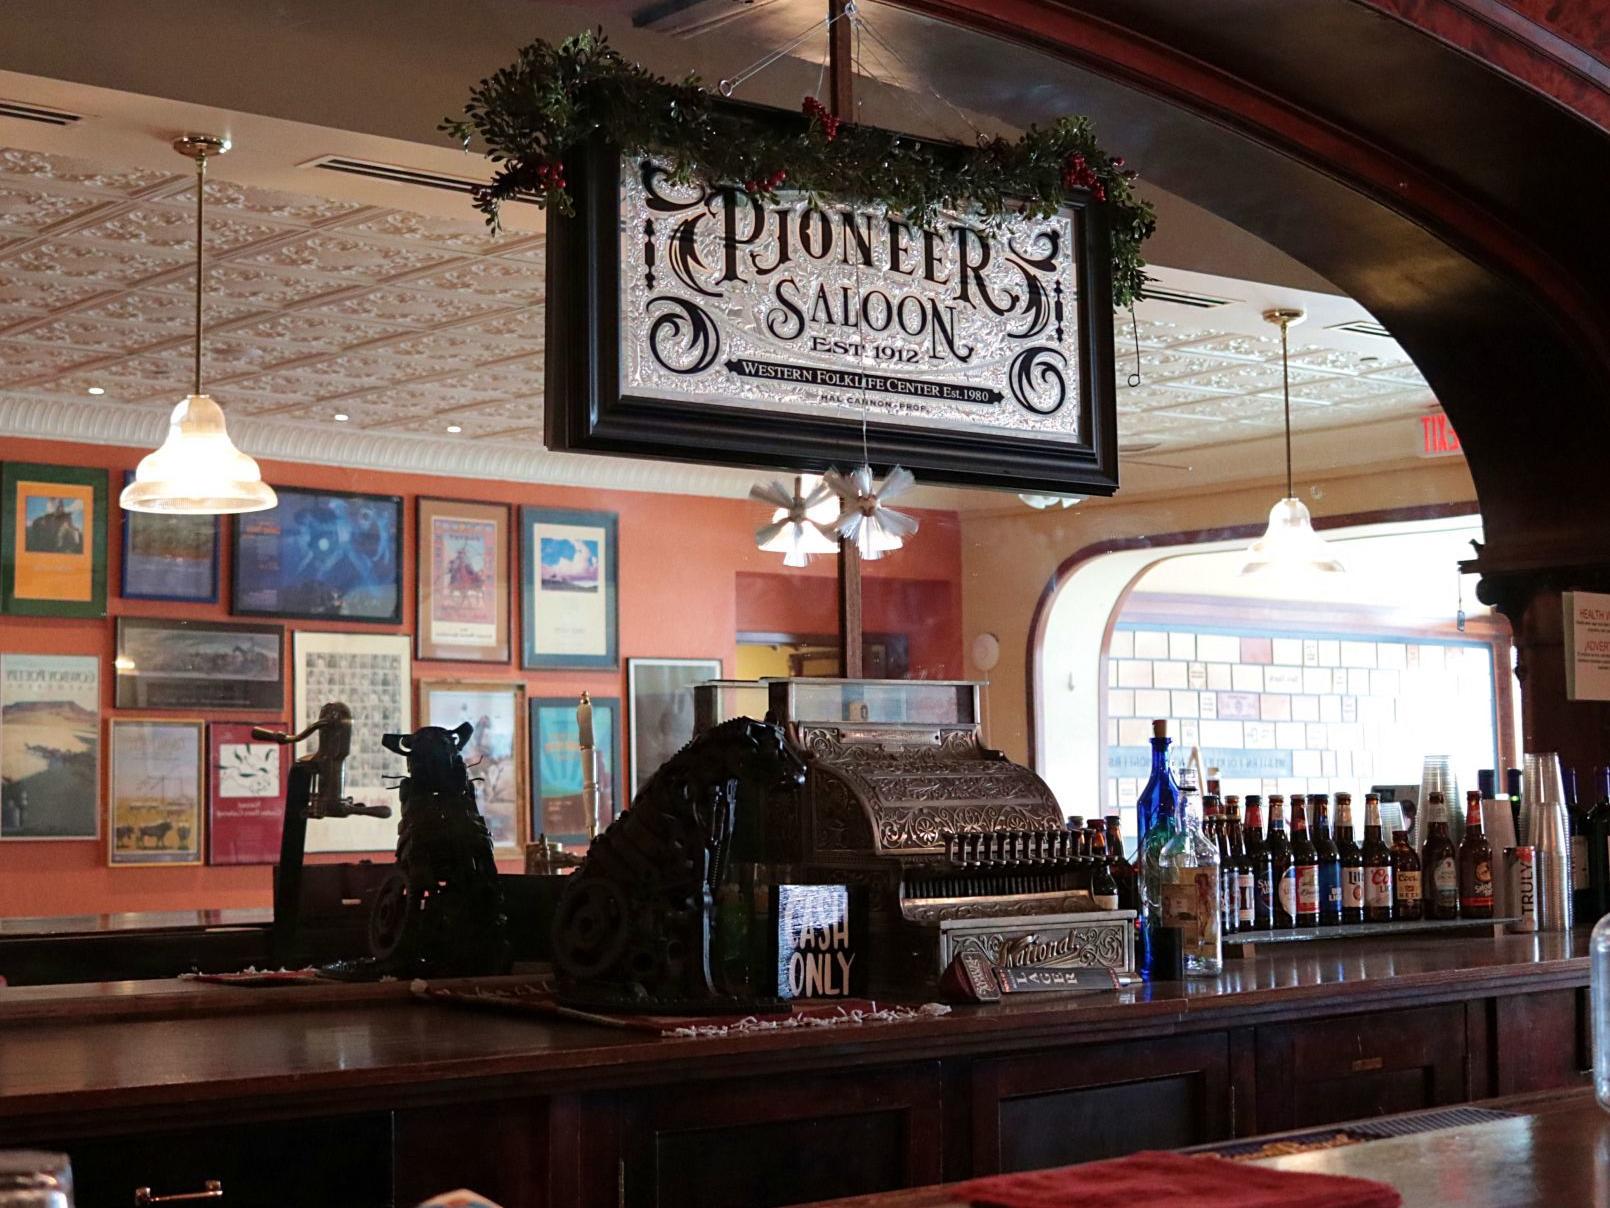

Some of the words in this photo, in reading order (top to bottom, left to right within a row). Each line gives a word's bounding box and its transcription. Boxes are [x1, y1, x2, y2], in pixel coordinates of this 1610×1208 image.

[702, 184, 1019, 317] PIONEER
[766, 276, 973, 362] SALOON
[810, 336, 864, 357] EST
[874, 346, 919, 364] 1912
[742, 361, 812, 381] WESTERN
[816, 370, 885, 391] FOLKLIFE
[886, 379, 940, 397] CENTER
[963, 388, 989, 402] 1980
[820, 394, 843, 403] HAL
[1520, 861, 1534, 916] TRULY
[785, 892, 849, 951] CASH
[788, 951, 856, 997] ONLY
[1016, 972, 1079, 985] LAGER
